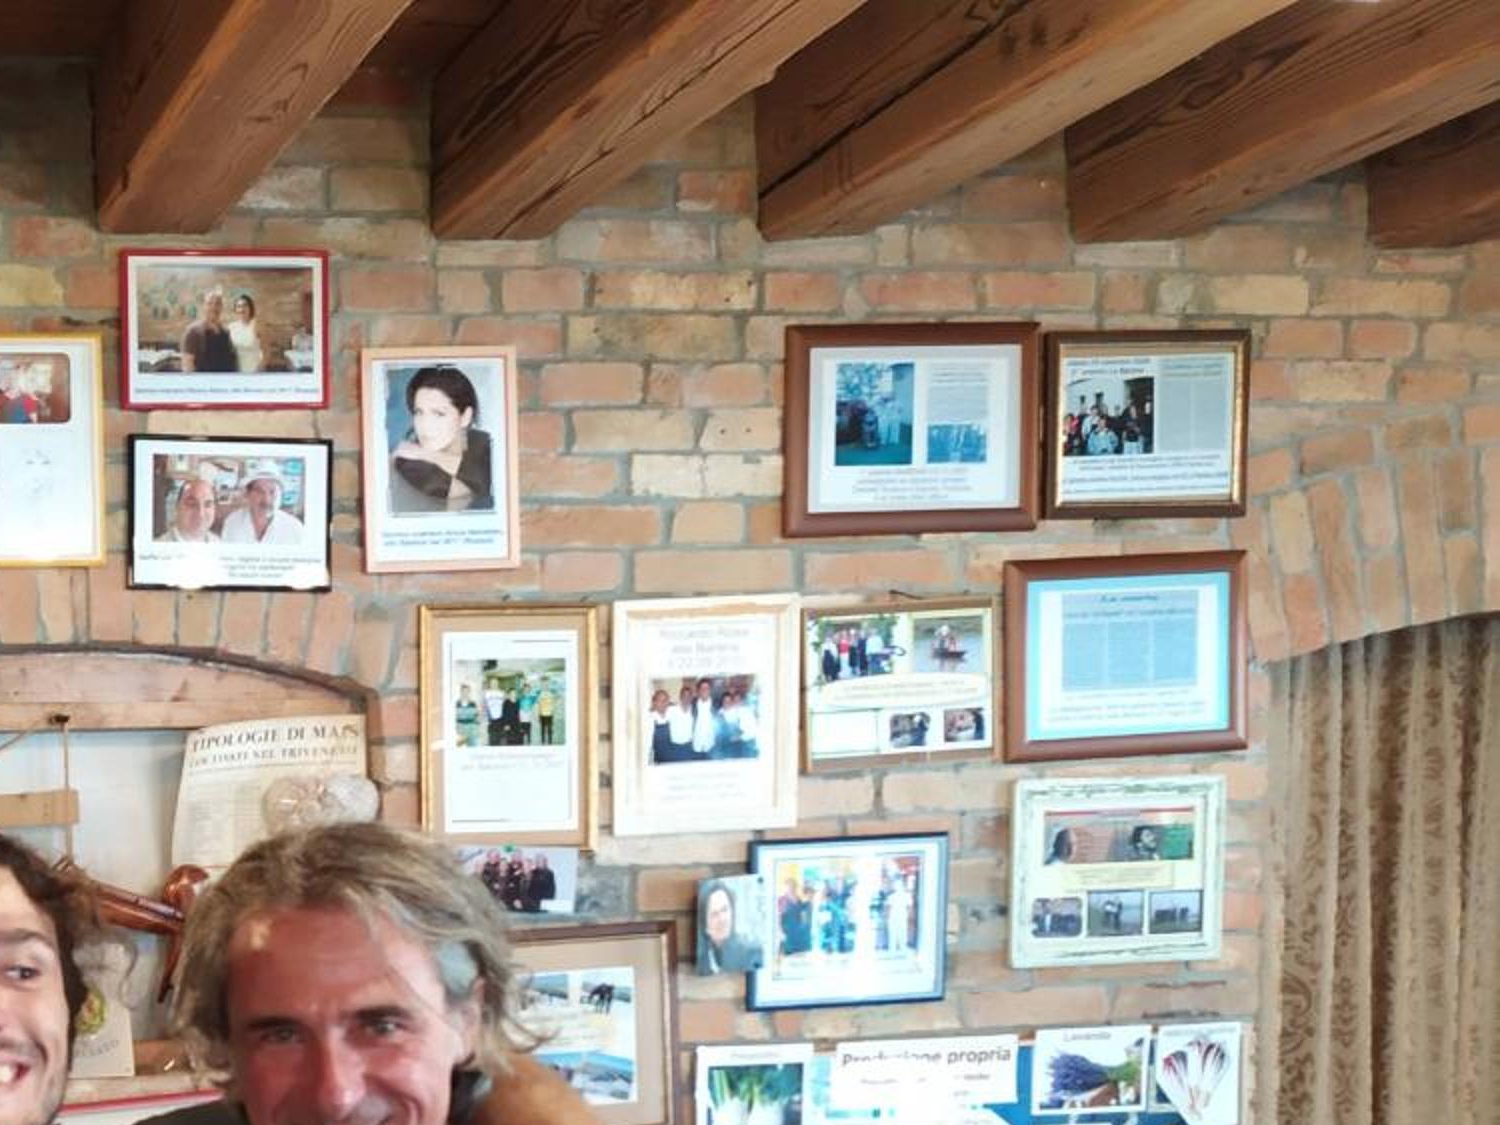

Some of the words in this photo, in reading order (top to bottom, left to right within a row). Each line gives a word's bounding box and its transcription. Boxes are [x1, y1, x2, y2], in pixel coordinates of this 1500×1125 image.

[193, 729, 278, 751] TIPOLOGIE
[287, 726, 304, 741] DI
[946, 1045, 1012, 1066] propria
